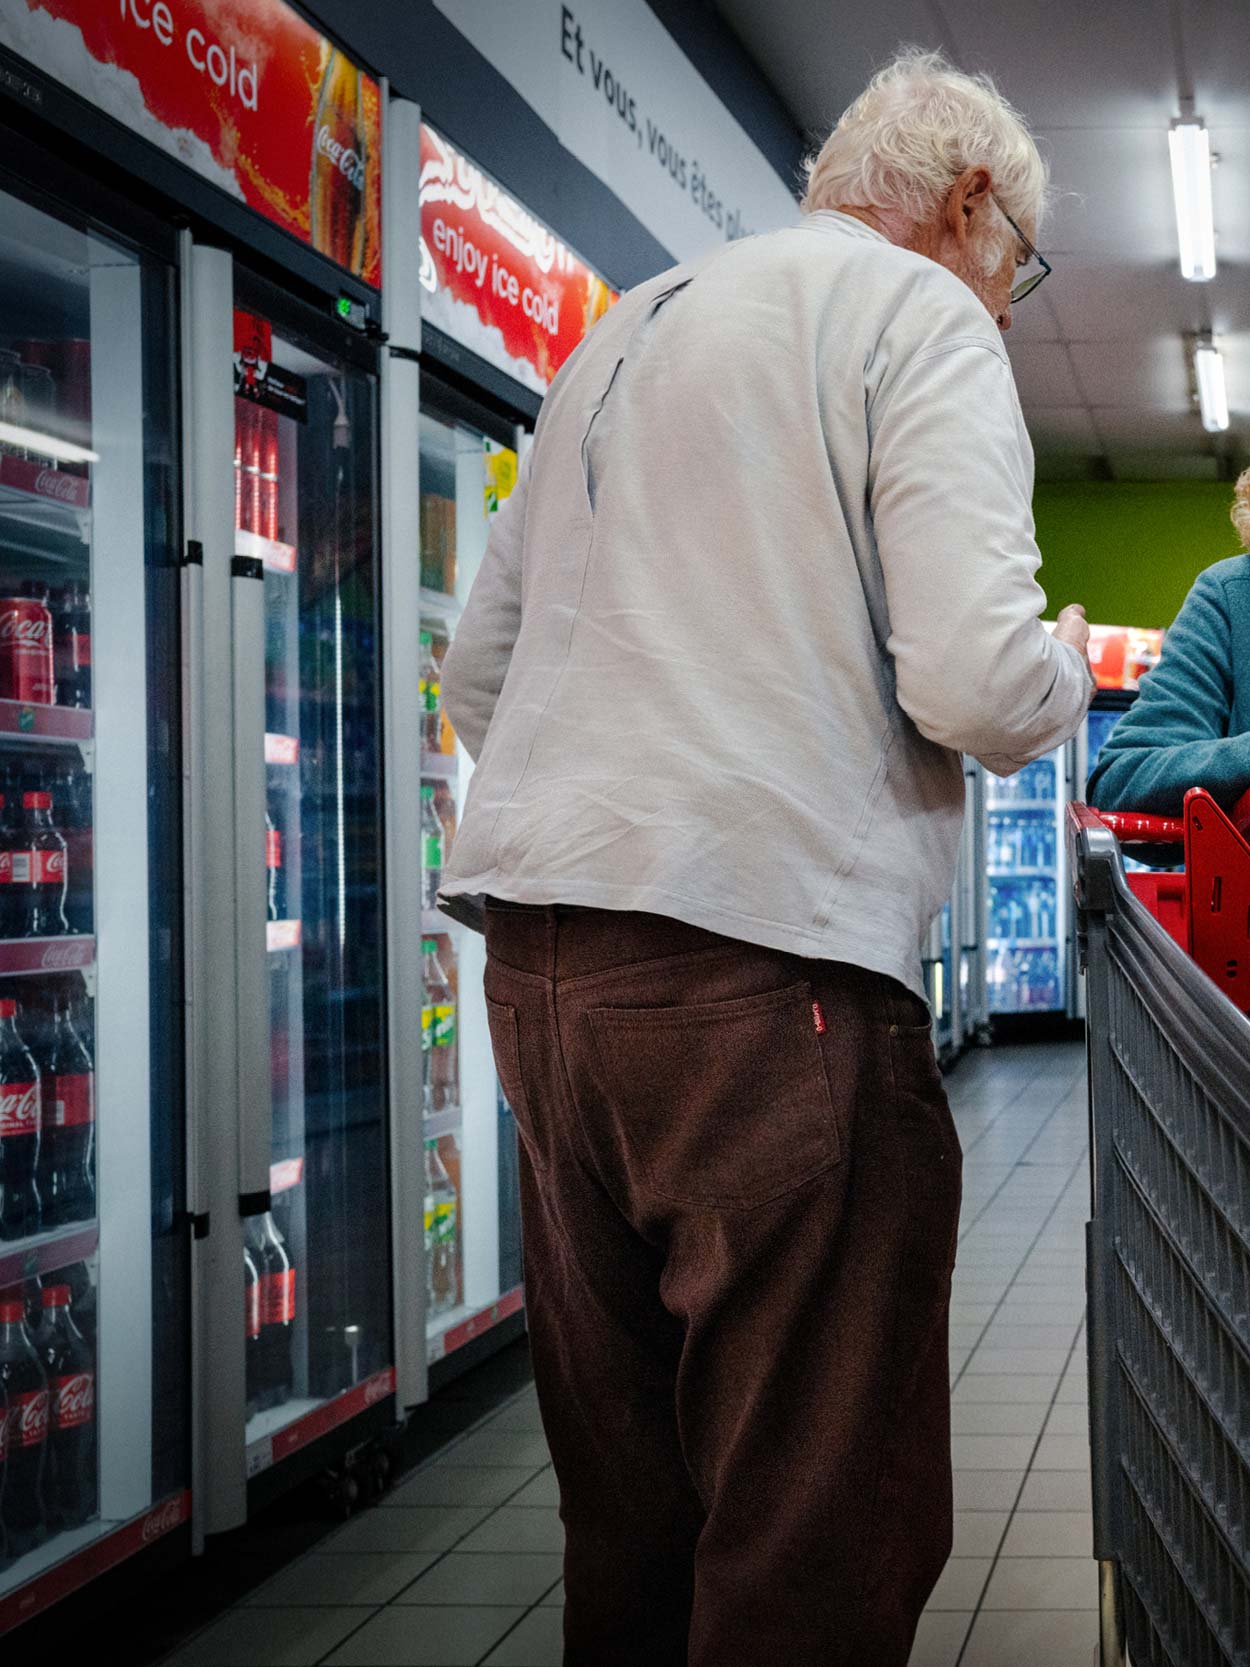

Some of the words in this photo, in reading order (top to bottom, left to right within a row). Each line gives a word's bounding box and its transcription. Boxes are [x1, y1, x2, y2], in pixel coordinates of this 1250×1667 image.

[186, 28, 258, 111] cold
[561, 3, 584, 75] Et
[589, 49, 644, 149] vous,
[646, 117, 687, 191] vous
[690, 159, 724, 230] êtes
[432, 218, 488, 289] enjoy
[491, 252, 520, 306] ice
[521, 286, 560, 336] cold
